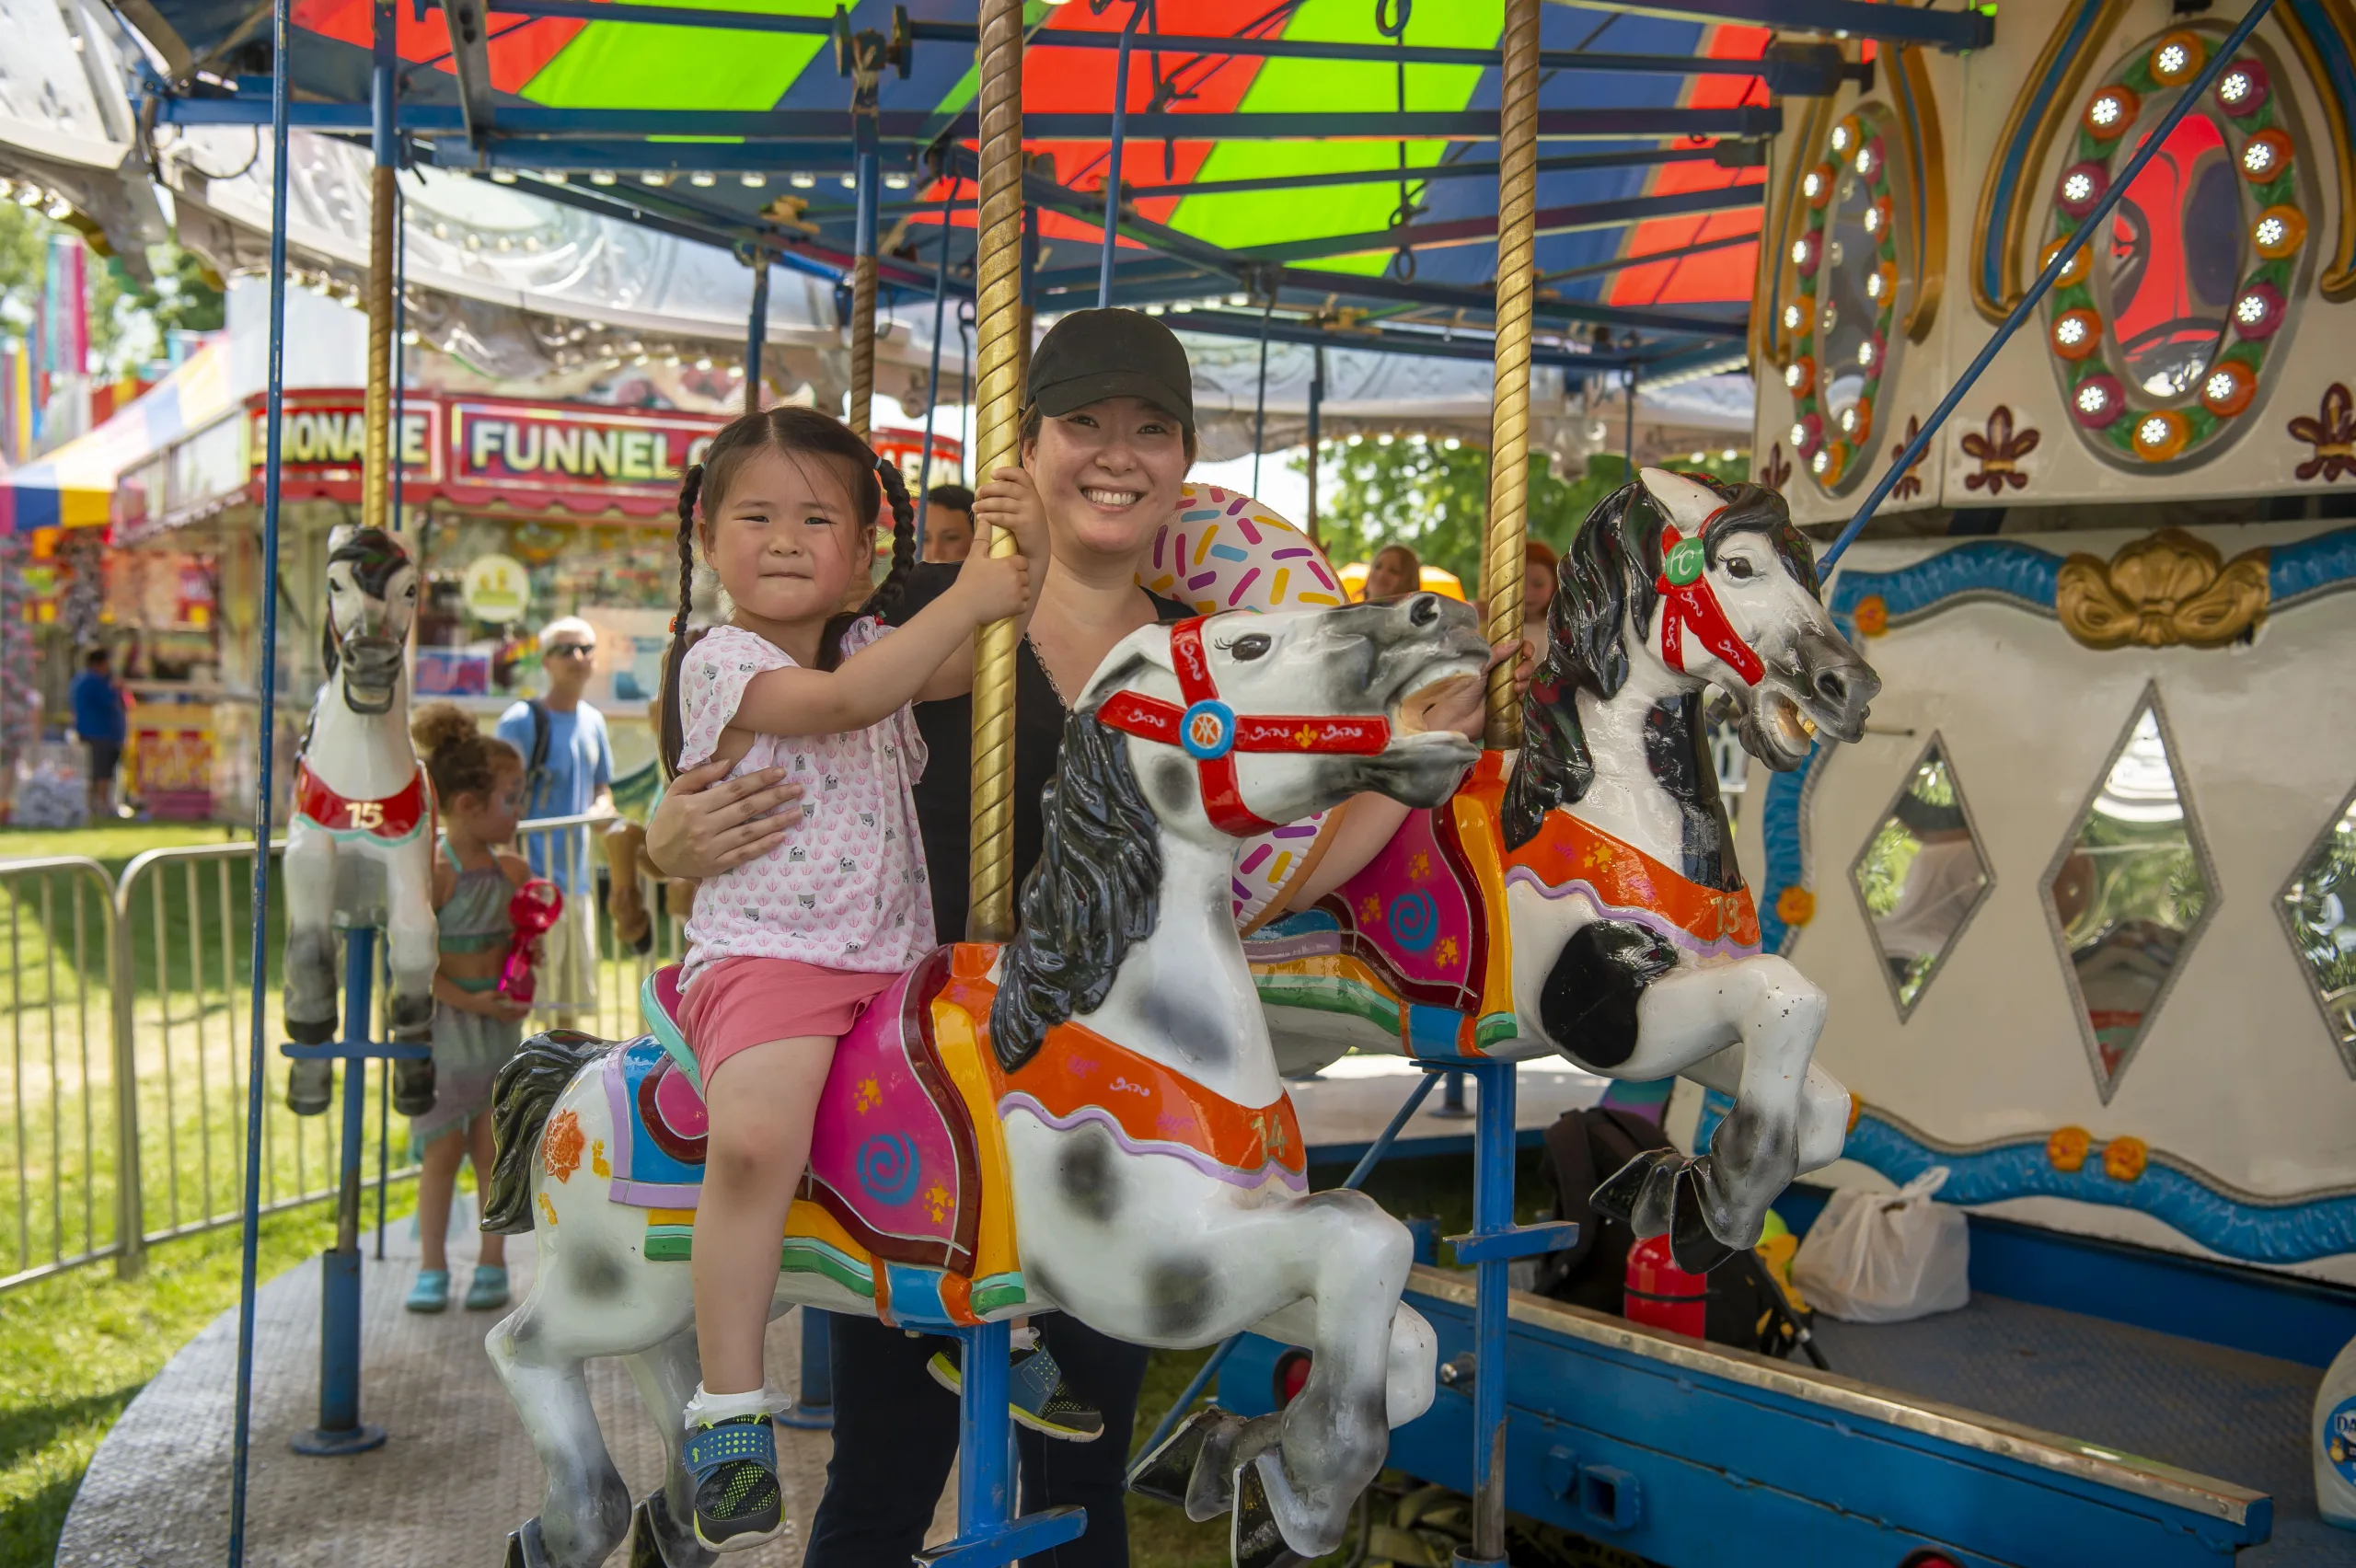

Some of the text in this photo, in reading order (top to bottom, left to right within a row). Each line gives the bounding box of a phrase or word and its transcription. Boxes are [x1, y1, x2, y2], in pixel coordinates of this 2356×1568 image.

[470, 420, 684, 479] FUNNEL
[345, 802, 384, 829] 15
[1710, 895, 1741, 934] 13
[1250, 1113, 1288, 1161] 14
